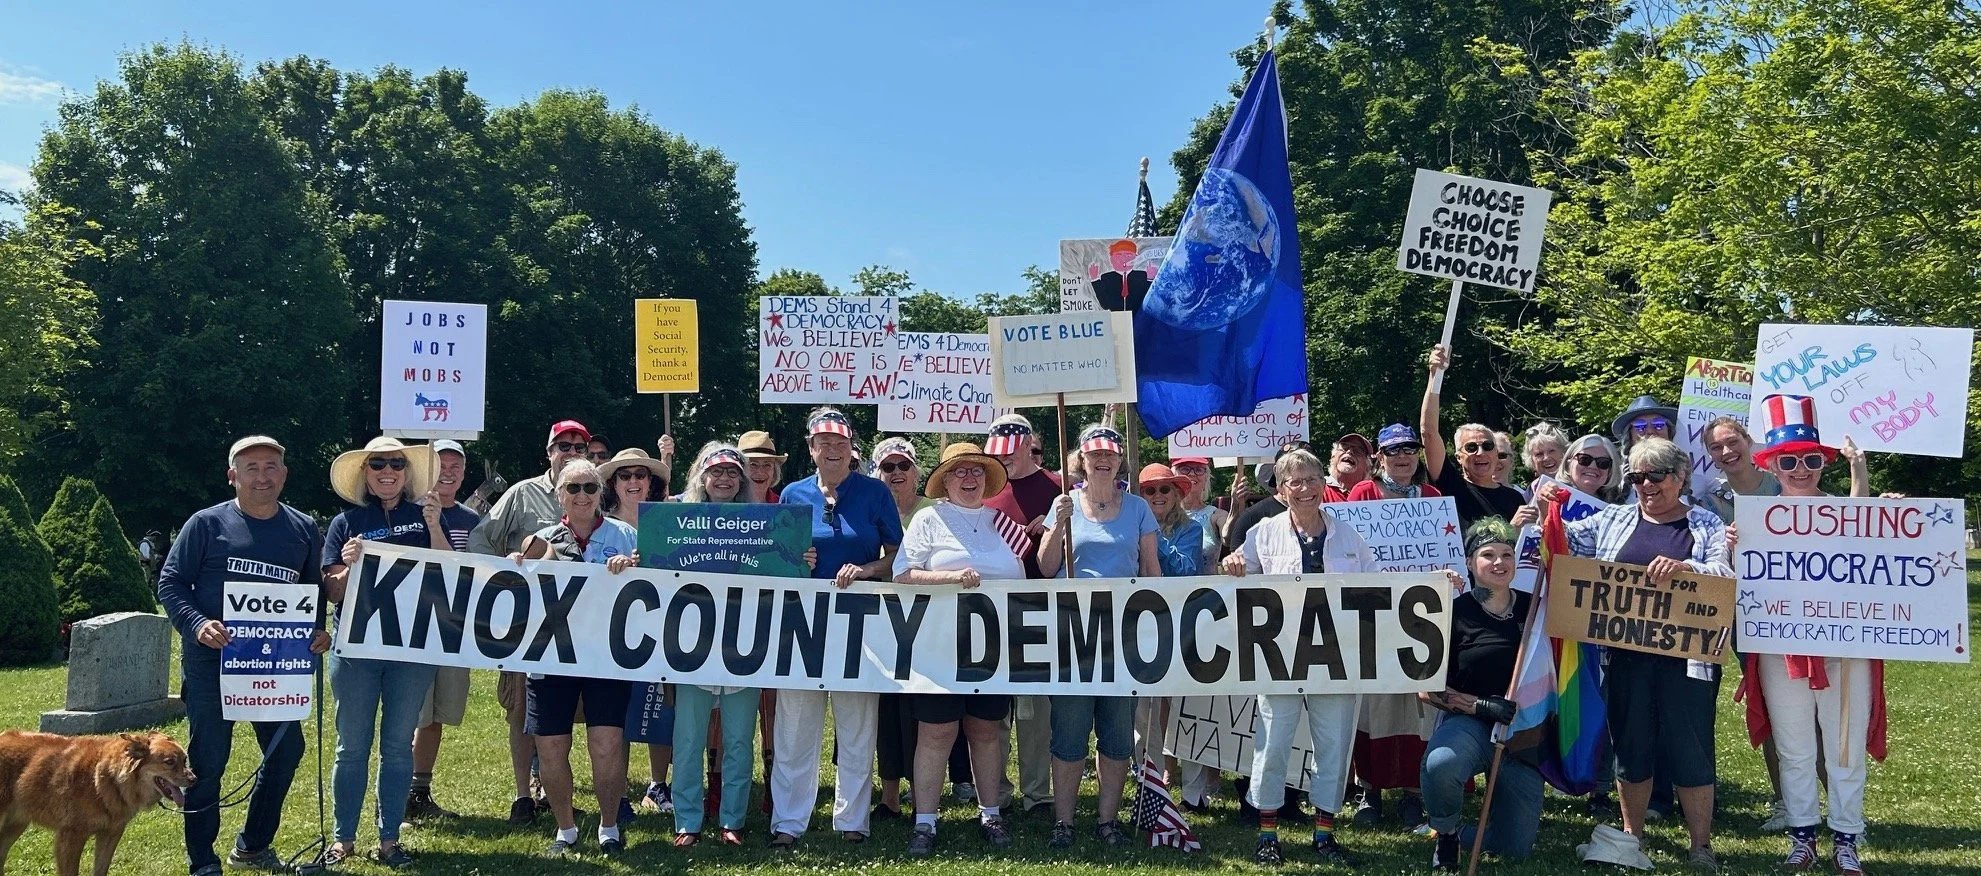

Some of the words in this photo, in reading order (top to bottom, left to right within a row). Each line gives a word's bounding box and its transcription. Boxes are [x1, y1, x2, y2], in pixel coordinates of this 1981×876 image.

[1440, 182, 1525, 216] CHOOSE
[1419, 226, 1519, 264] FREEDOM
[1406, 248, 1532, 289] DEMOCRACY
[653, 303, 662, 312] If
[663, 306, 680, 315] you
[768, 297, 817, 313] DEMS
[826, 297, 871, 313] Stand
[880, 299, 892, 313] 4
[1062, 300, 1093, 311] SMOKE
[405, 312, 465, 328] JOBS
[656, 317, 678, 326] have
[787, 314, 885, 330] DEMOCRACY
[653, 331, 682, 340] Social
[764, 330, 793, 347] We
[802, 330, 884, 348] BELIEVE
[1004, 325, 1051, 342] VOTE
[1060, 321, 1104, 339] BLUE
[1761, 326, 1795, 355] GET
[413, 340, 455, 356] NOT
[898, 334, 930, 350] EMS
[935, 335, 944, 350] 4
[947, 335, 990, 352] Democr
[652, 358, 679, 367] thank
[774, 350, 810, 369] NO
[820, 351, 856, 369] ONE
[925, 355, 991, 375] BELIEVE
[1013, 365, 1026, 374] NO
[1031, 361, 1073, 373] MATTER
[1759, 345, 1828, 390] YOUR
[404, 368, 461, 383] MOBS
[643, 372, 693, 381] Democrat!
[761, 373, 812, 393] ABOVE
[819, 376, 840, 391] the
[848, 371, 898, 400] LAW!
[898, 380, 953, 401] Climate
[959, 383, 993, 404] Chan
[1830, 372, 1869, 404] OFF
[928, 402, 986, 424] REAL
[1287, 408, 1305, 427] of
[1688, 409, 1716, 423] END
[1871, 391, 1940, 443] BODY
[1174, 429, 1233, 447] Church
[1237, 430, 1248, 444] &
[1380, 500, 1433, 520] STAND
[1438, 500, 1451, 516] 4
[677, 517, 711, 530] Valli
[714, 517, 767, 533] Geiger
[1356, 519, 1439, 540] EMOCRACY
[1764, 504, 1925, 538] CUSHING
[708, 537, 773, 546] Representative
[680, 552, 712, 567] We're
[715, 550, 727, 560] all
[729, 551, 738, 561] in
[741, 553, 759, 568] this
[1369, 542, 1439, 562] BELIEVE
[1447, 542, 1464, 559] in
[228, 558, 263, 574] TRUTH
[1741, 550, 1936, 587] DEMOCRATS
[1670, 579, 1697, 592] FOR
[227, 594, 287, 613] Vote
[296, 596, 313, 614] 4
[1570, 578, 1673, 619] TRUTH
[1685, 602, 1718, 617] AND
[347, 554, 588, 664] KNOX
[609, 579, 931, 681] COUNTY
[956, 585, 1445, 684] DEMOCRATS
[1764, 600, 1791, 616] WE
[1803, 601, 1886, 620] BELIEVE
[1892, 604, 1911, 621] IN
[227, 627, 312, 639] DEMOCRACY
[1587, 612, 1730, 657] HONESTY!
[1745, 621, 1856, 642] DEMOCRATIC
[262, 643, 271, 654] &
[224, 658, 272, 669] abortion
[276, 658, 311, 670] rights
[252, 680, 276, 689] not
[224, 694, 309, 706] Dictatorship
[641, 685, 655, 735] REPROD
